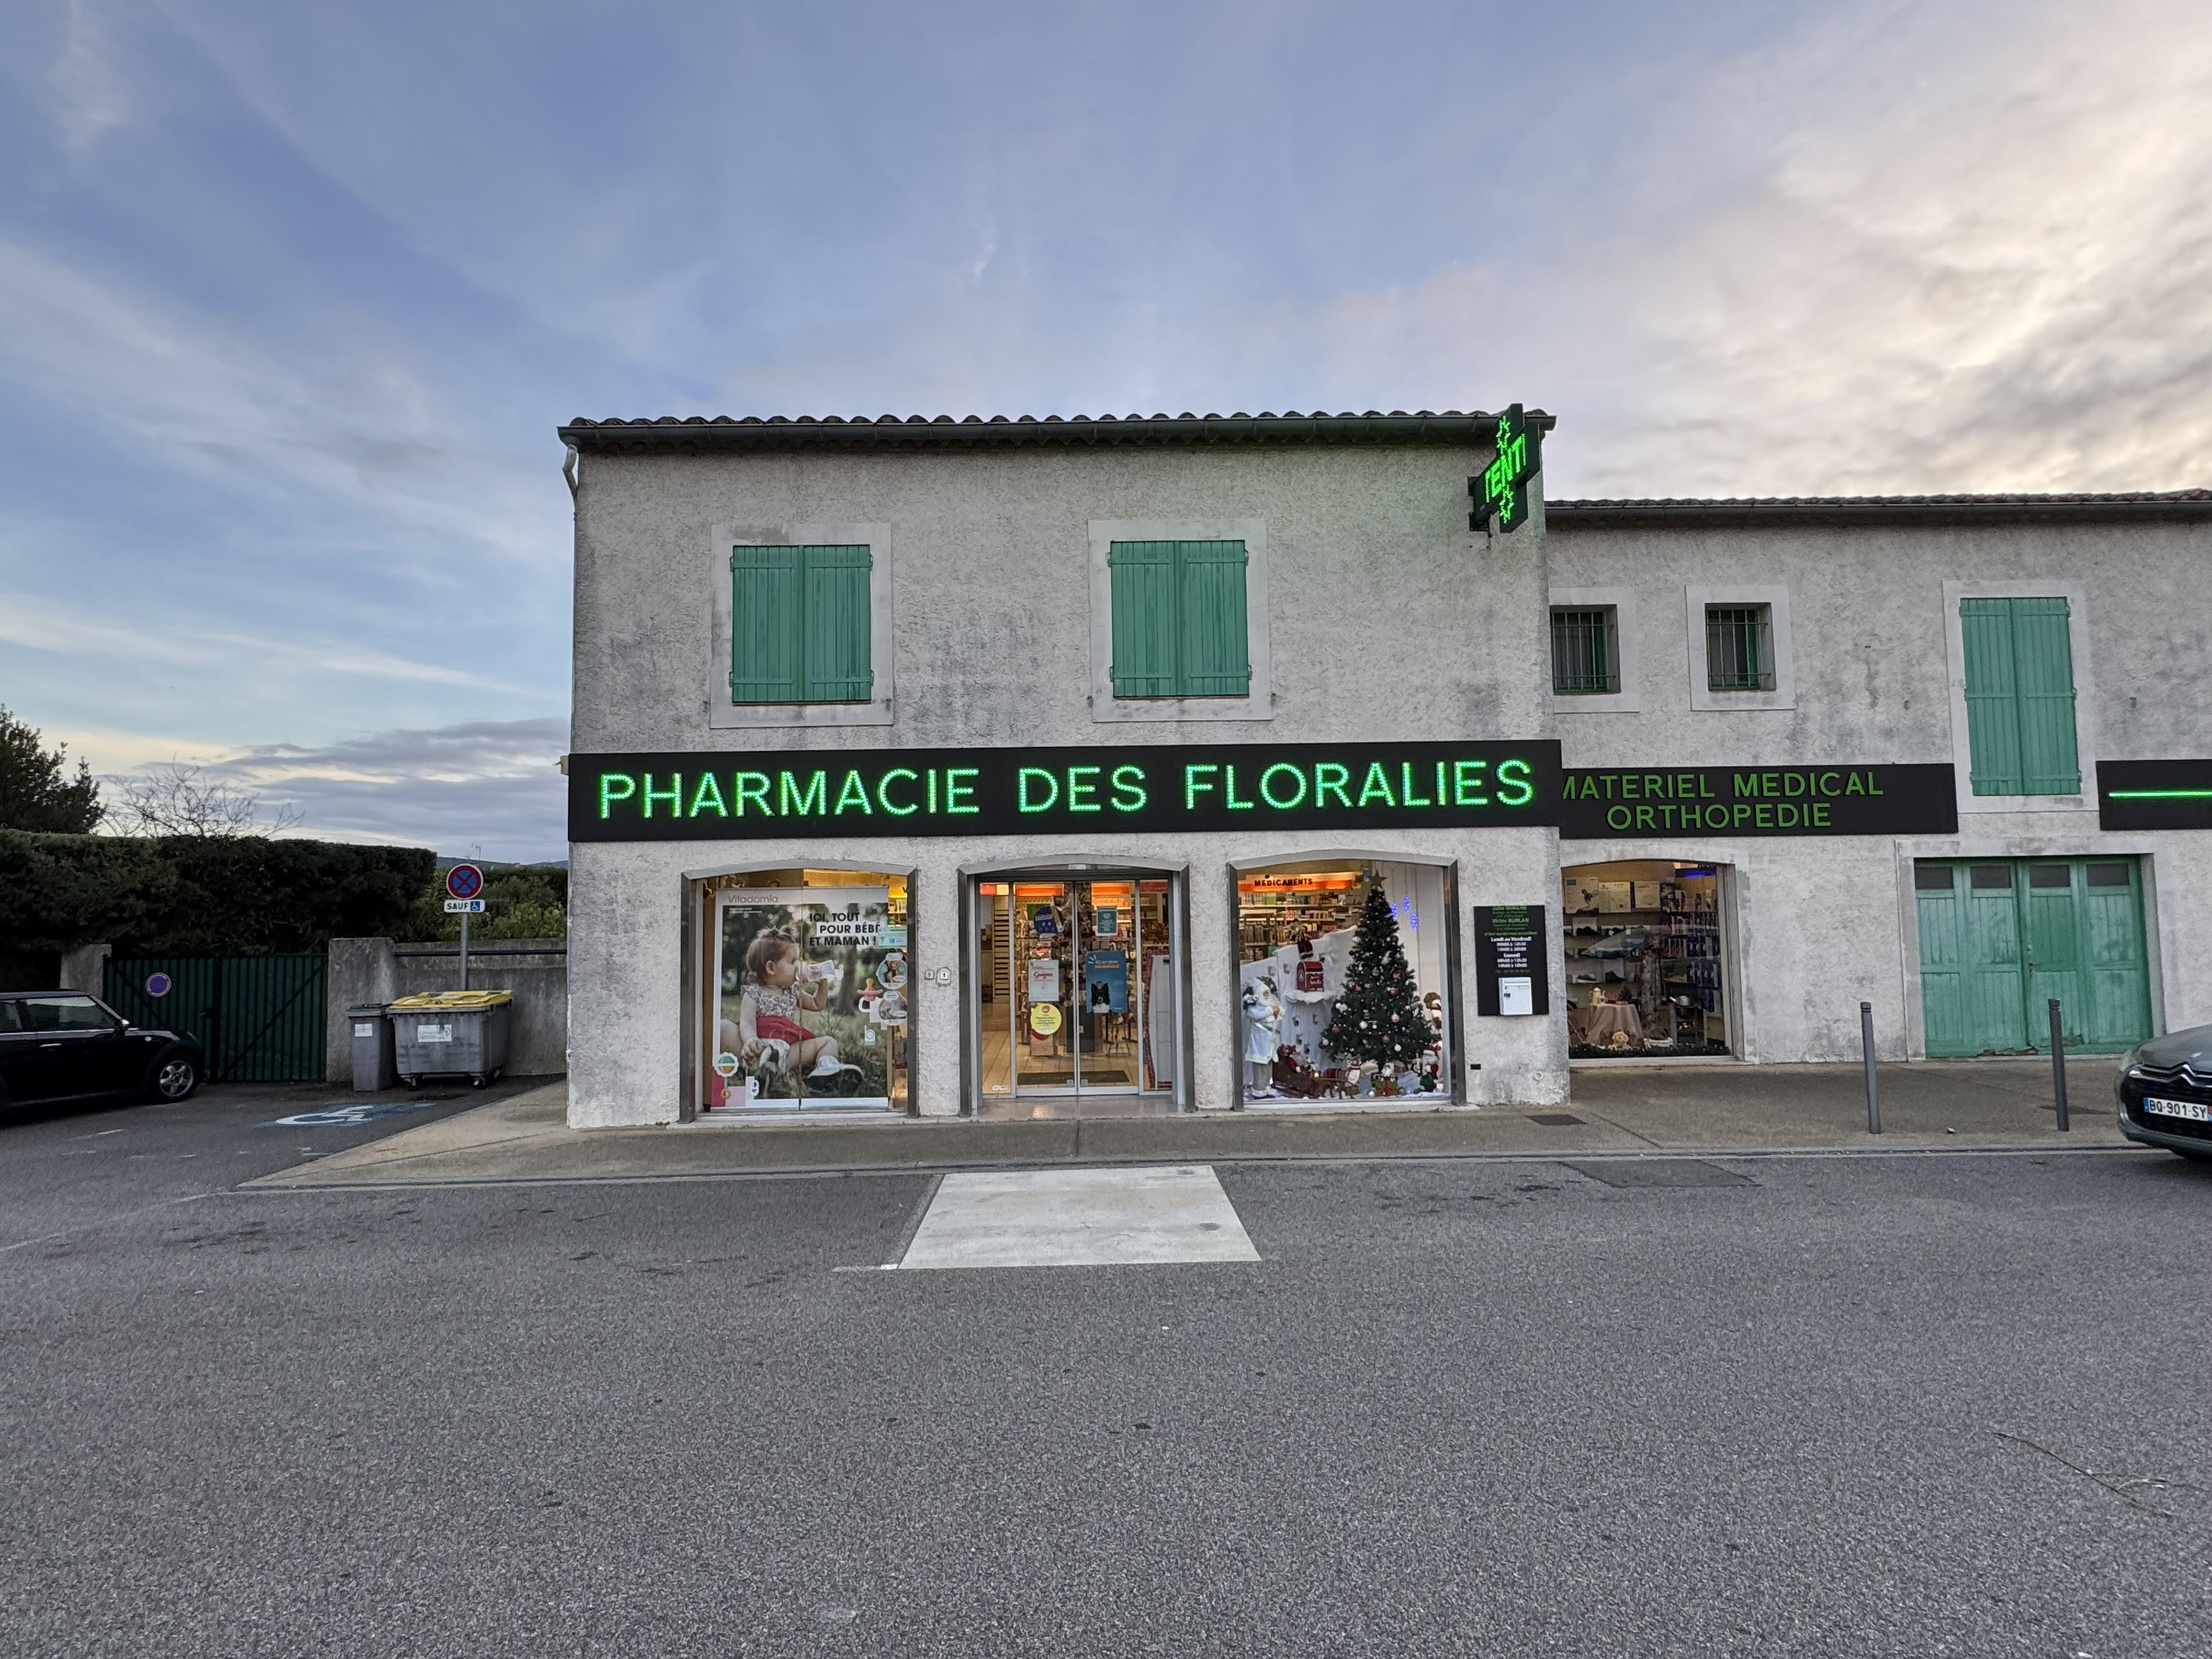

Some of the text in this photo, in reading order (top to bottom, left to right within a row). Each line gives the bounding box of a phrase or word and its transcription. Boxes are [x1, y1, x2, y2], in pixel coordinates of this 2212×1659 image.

[600, 759, 1534, 819] PHARMACIE DES FLORALIES
[1734, 772, 1883, 797] MEDICAL
[1607, 803, 1831, 830] ORTHOPEDIE
[1254, 878, 1313, 887] MEDICAMENTS
[810, 912, 860, 923] ICI, TOUT
[820, 925, 851, 933] POUR
[810, 936, 876, 946] ET MAMAN !
[2149, 1099, 2206, 1119] BQ-901-SY
